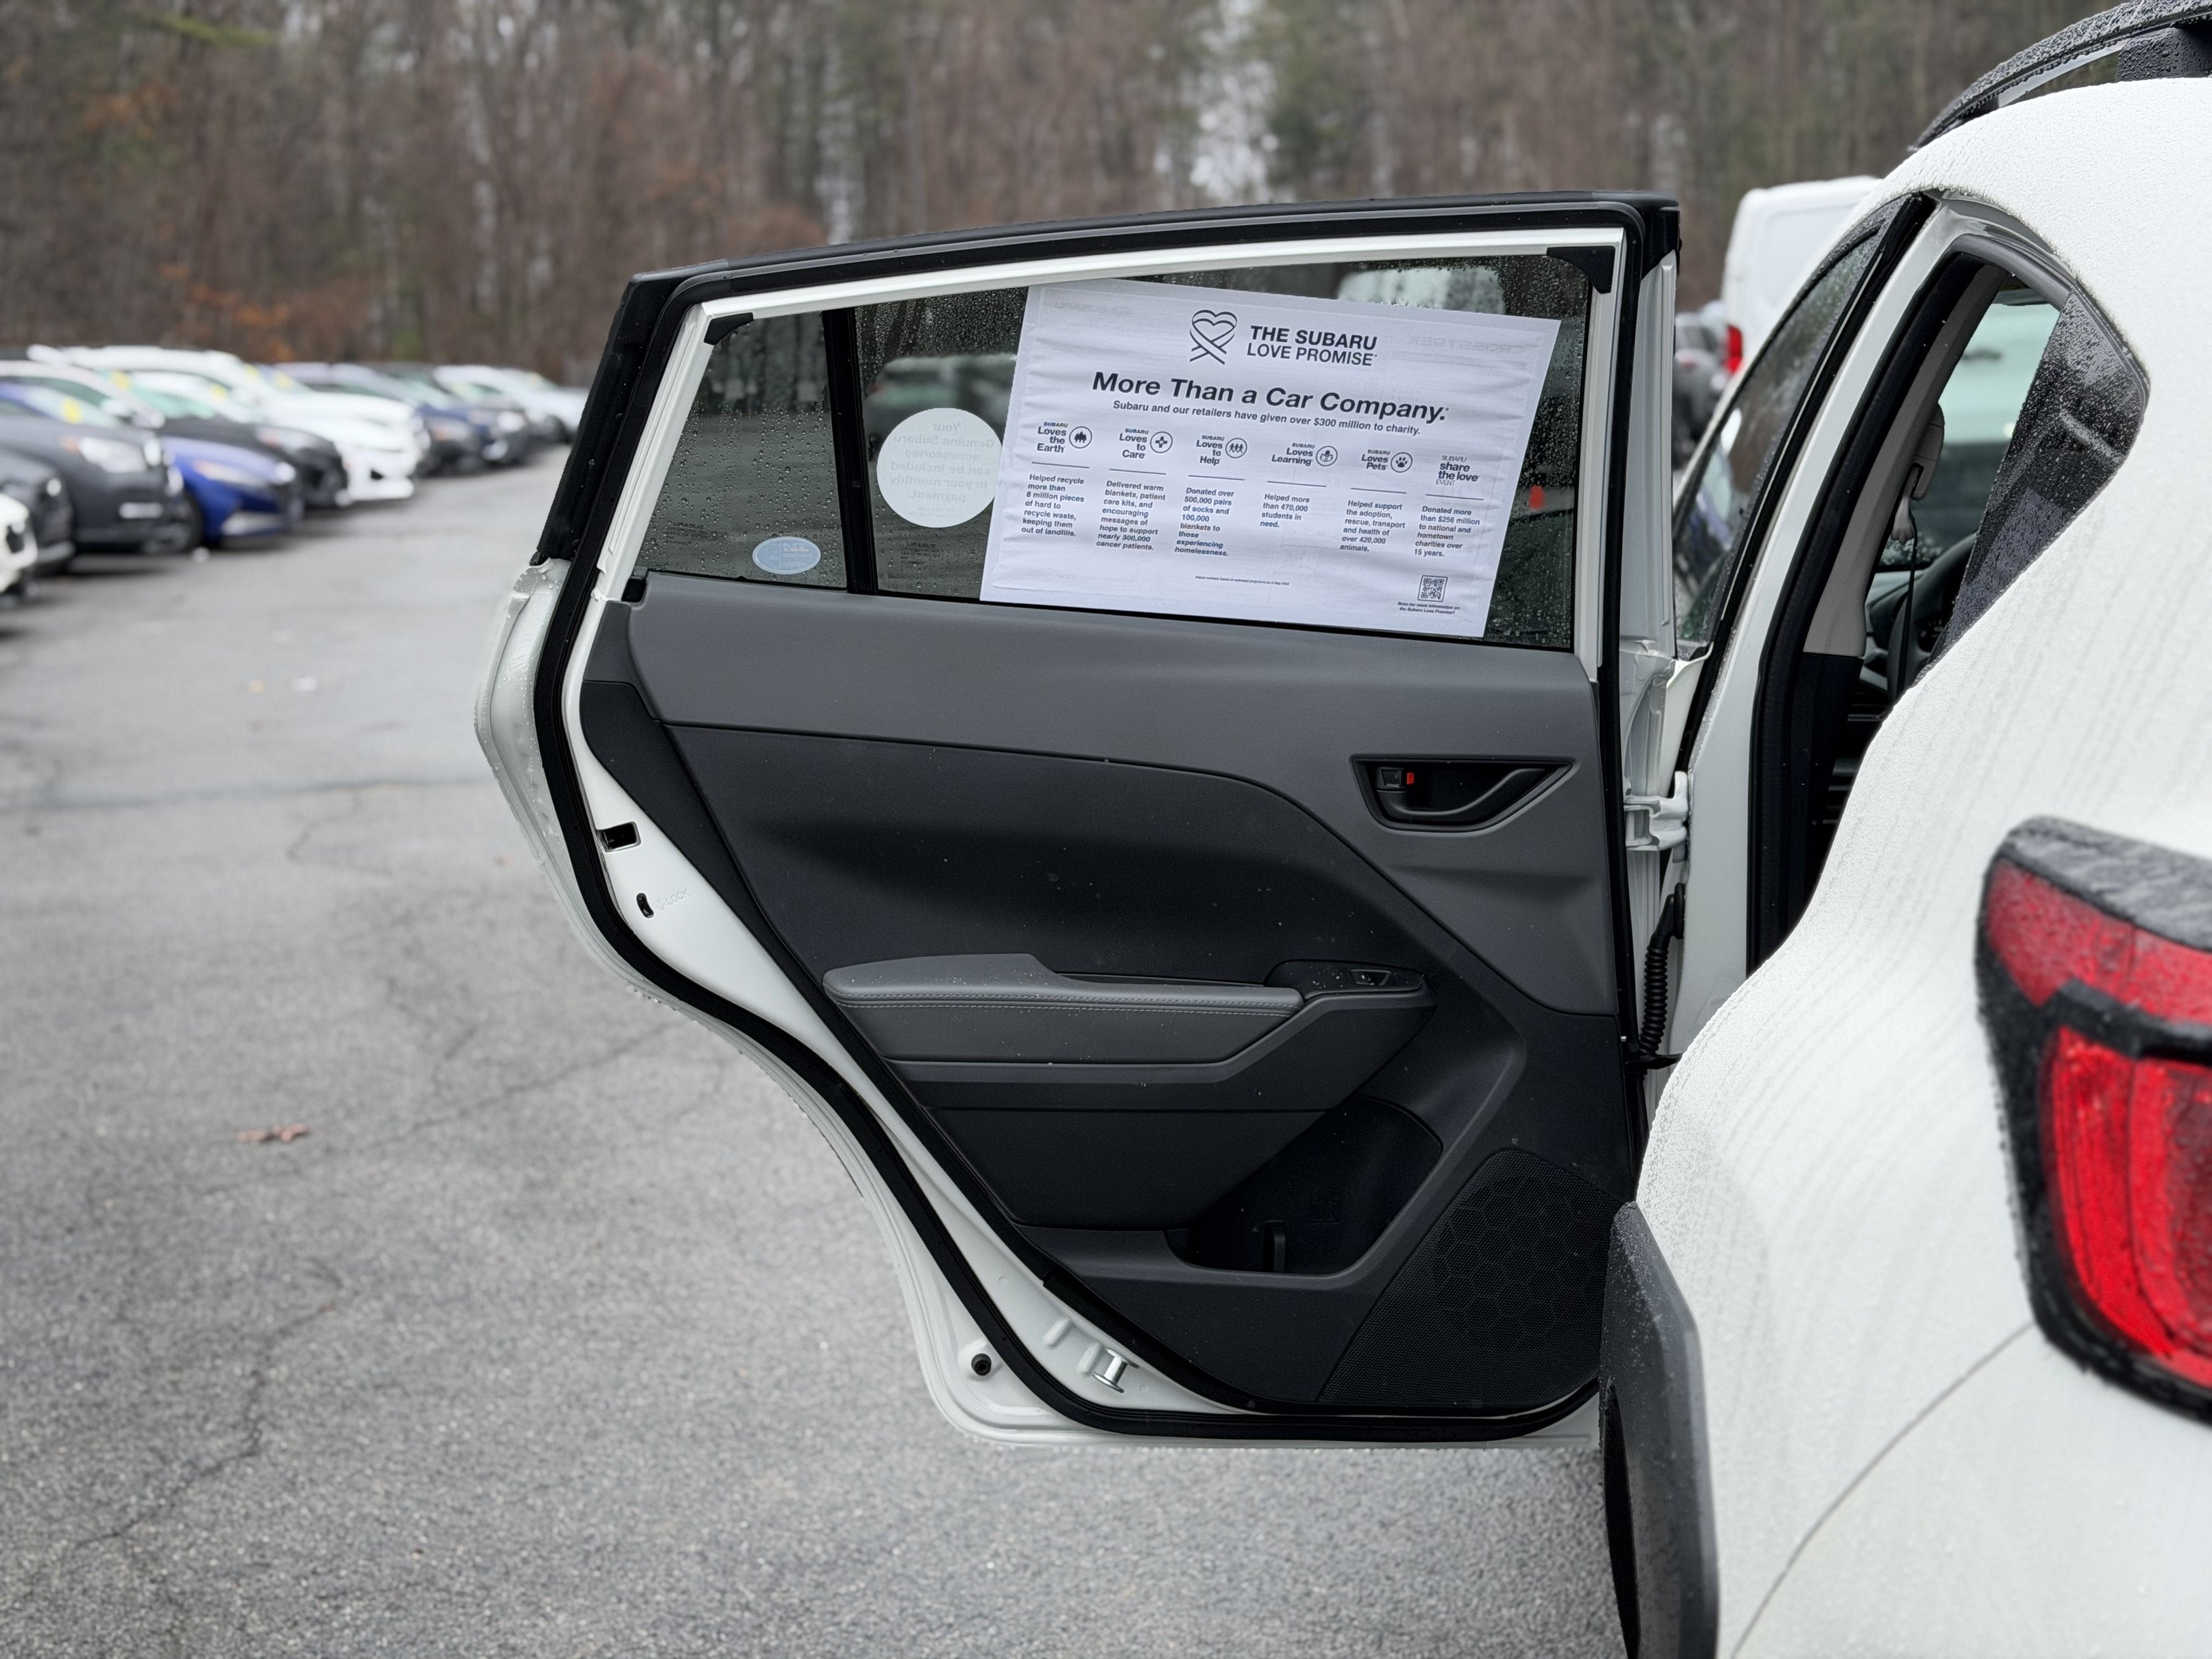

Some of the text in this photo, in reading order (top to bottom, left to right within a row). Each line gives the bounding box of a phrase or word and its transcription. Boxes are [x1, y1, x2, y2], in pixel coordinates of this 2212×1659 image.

[1250, 325, 1378, 351] THE SUBARU
[1246, 342, 1374, 366] LOVE PROMISE
[1092, 371, 1447, 424] More Than a Car Company.
[1113, 400, 1149, 411] Subaru
[1151, 404, 1170, 413] and
[1192, 408, 1232, 417] retailers
[1234, 410, 1257, 420] have
[1260, 413, 1286, 422] given
[1313, 417, 1336, 427] $300
[1338, 420, 1371, 430] million
[1374, 422, 1383, 431] to
[1386, 424, 1420, 436] charity.
[1037, 426, 1066, 436] Loves
[1049, 436, 1065, 444] the
[1119, 432, 1147, 443] Loves
[1136, 443, 1146, 451] to
[1196, 439, 1223, 449] Loves
[1286, 447, 1313, 456] Loves
[1361, 453, 1388, 463] Loves
[1439, 461, 1470, 472] share
[1029, 473, 1056, 483] Helped
[1438, 470, 1455, 479] the
[1106, 480, 1142, 489] Delivered
[1104, 489, 1138, 499] blankets,
[1186, 487, 1217, 495] Donated
[1184, 496, 1212, 504] 500,000
[1264, 493, 1290, 502] Helped
[1121, 499, 1137, 507] kits,
[1347, 500, 1373, 509] Helped
[1280, 504, 1308, 512] 470,000
[1421, 505, 1452, 514] Donated
[1024, 510, 1076, 521] recycle waste,
[1102, 508, 1148, 518] encouraging
[1261, 511, 1293, 520] students
[1359, 510, 1392, 520] adoption,
[1022, 517, 1052, 527] keeping
[1101, 517, 1138, 526] messages
[1182, 514, 1209, 522] 100,000
[1180, 522, 1211, 531] blankets
[1345, 518, 1405, 529] rescue, transport
[1045, 528, 1076, 537] landfills.
[1099, 524, 1118, 533] hope
[1359, 536, 1386, 544] 420,000
[1417, 532, 1453, 540] hometown
[1176, 540, 1223, 549] experiencing
[1415, 540, 1445, 548] charities
[1174, 546, 1228, 556] homelessness.
